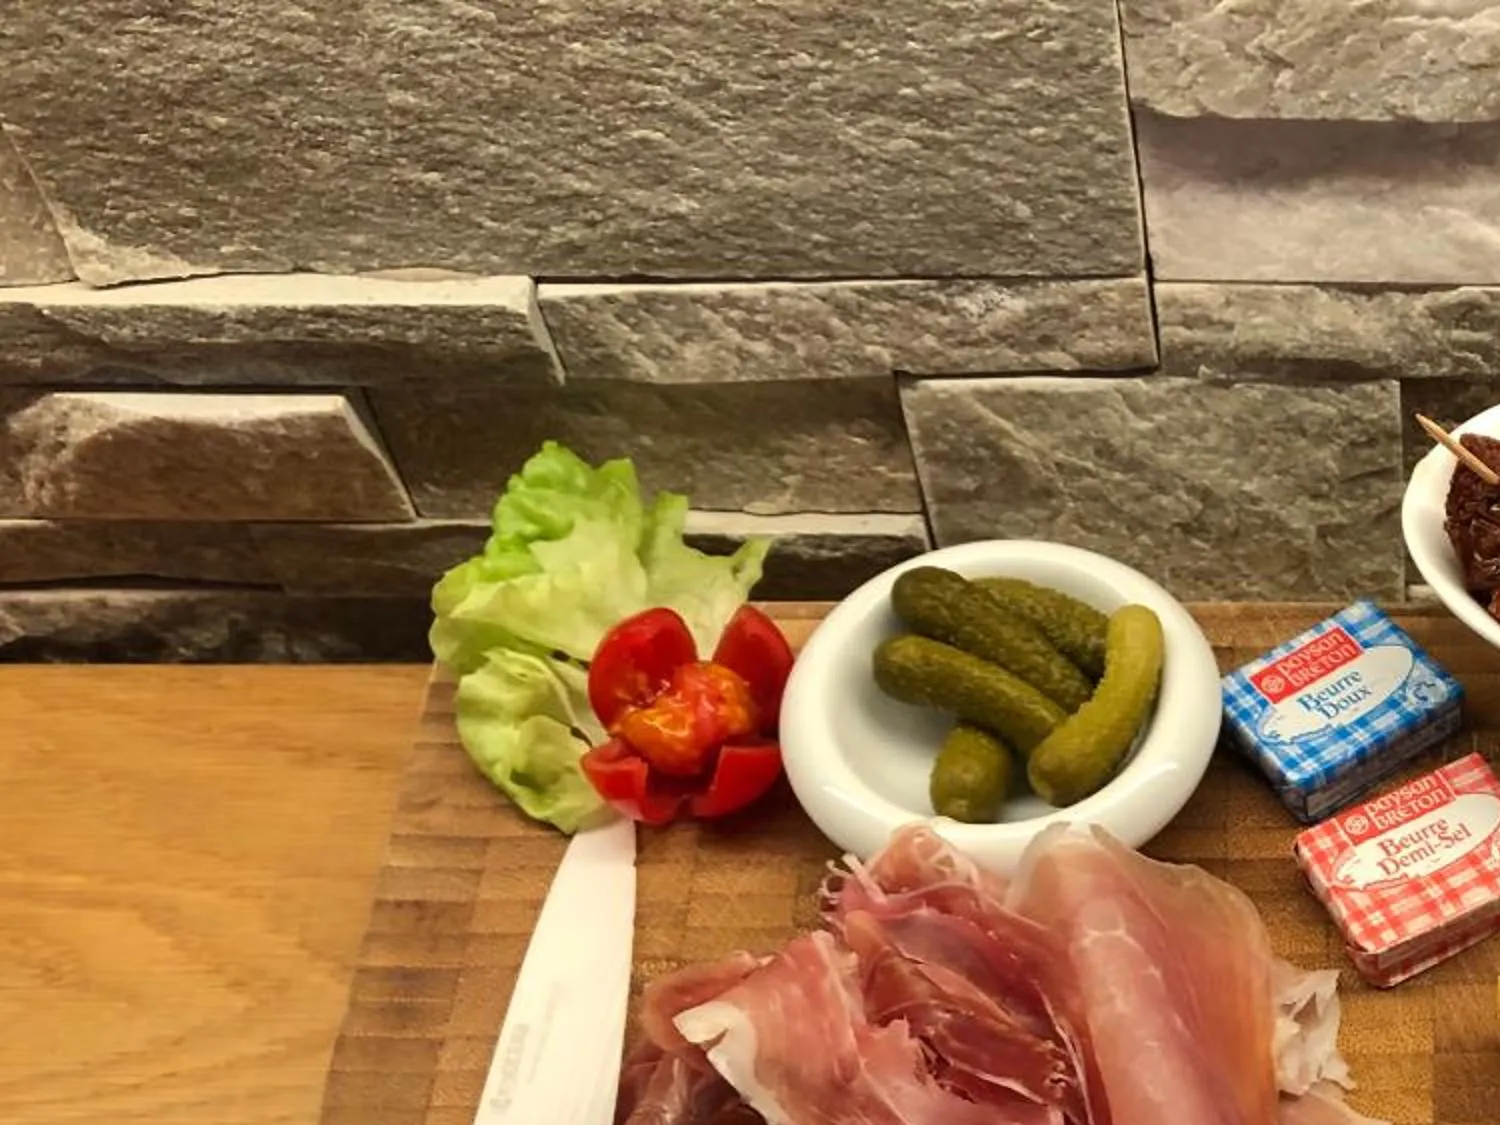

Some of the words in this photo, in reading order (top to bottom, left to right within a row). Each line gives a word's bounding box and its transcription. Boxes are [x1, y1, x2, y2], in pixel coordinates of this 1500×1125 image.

[1296, 670, 1363, 711] Beurre
[1318, 687, 1373, 719] Doux
[1376, 818, 1449, 857] Beurre
[1376, 822, 1472, 875] Demi-Sel
